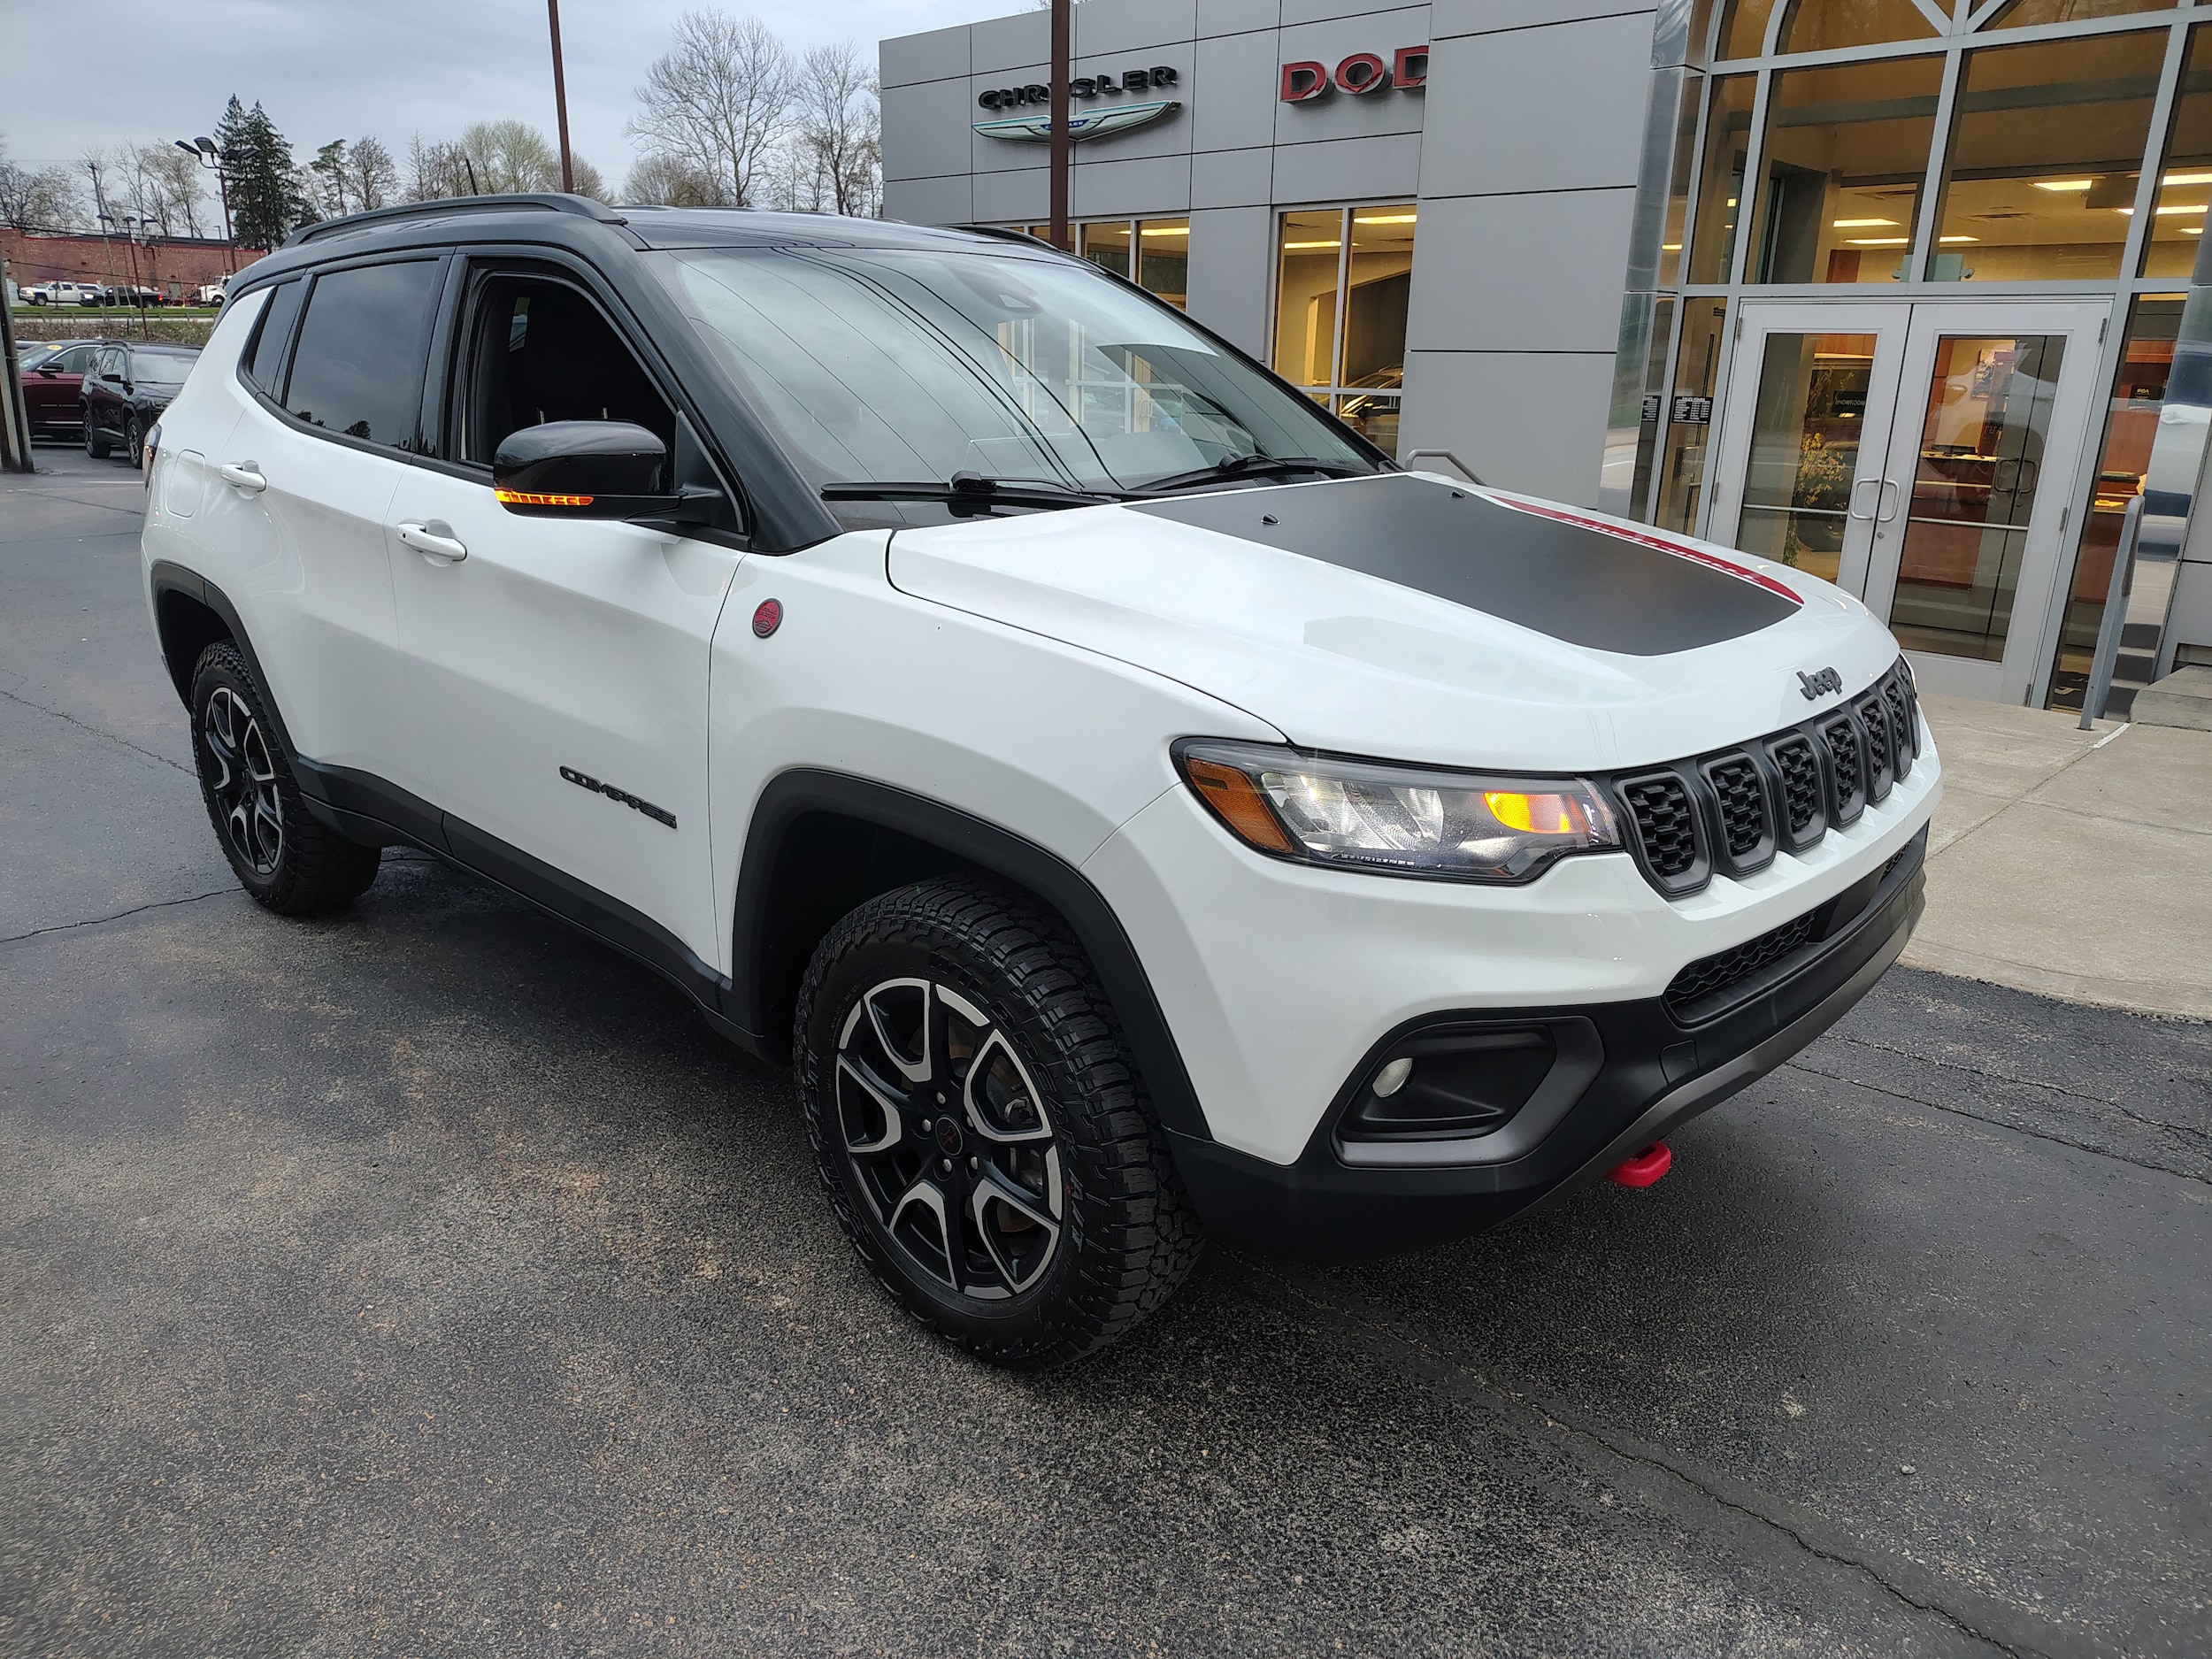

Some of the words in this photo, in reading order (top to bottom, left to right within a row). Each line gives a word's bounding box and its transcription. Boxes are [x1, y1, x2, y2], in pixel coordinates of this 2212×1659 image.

[979, 66, 1177, 109] CHRSLER
[1796, 667, 1842, 701] Jeep
[559, 765, 677, 829] COMPASS
